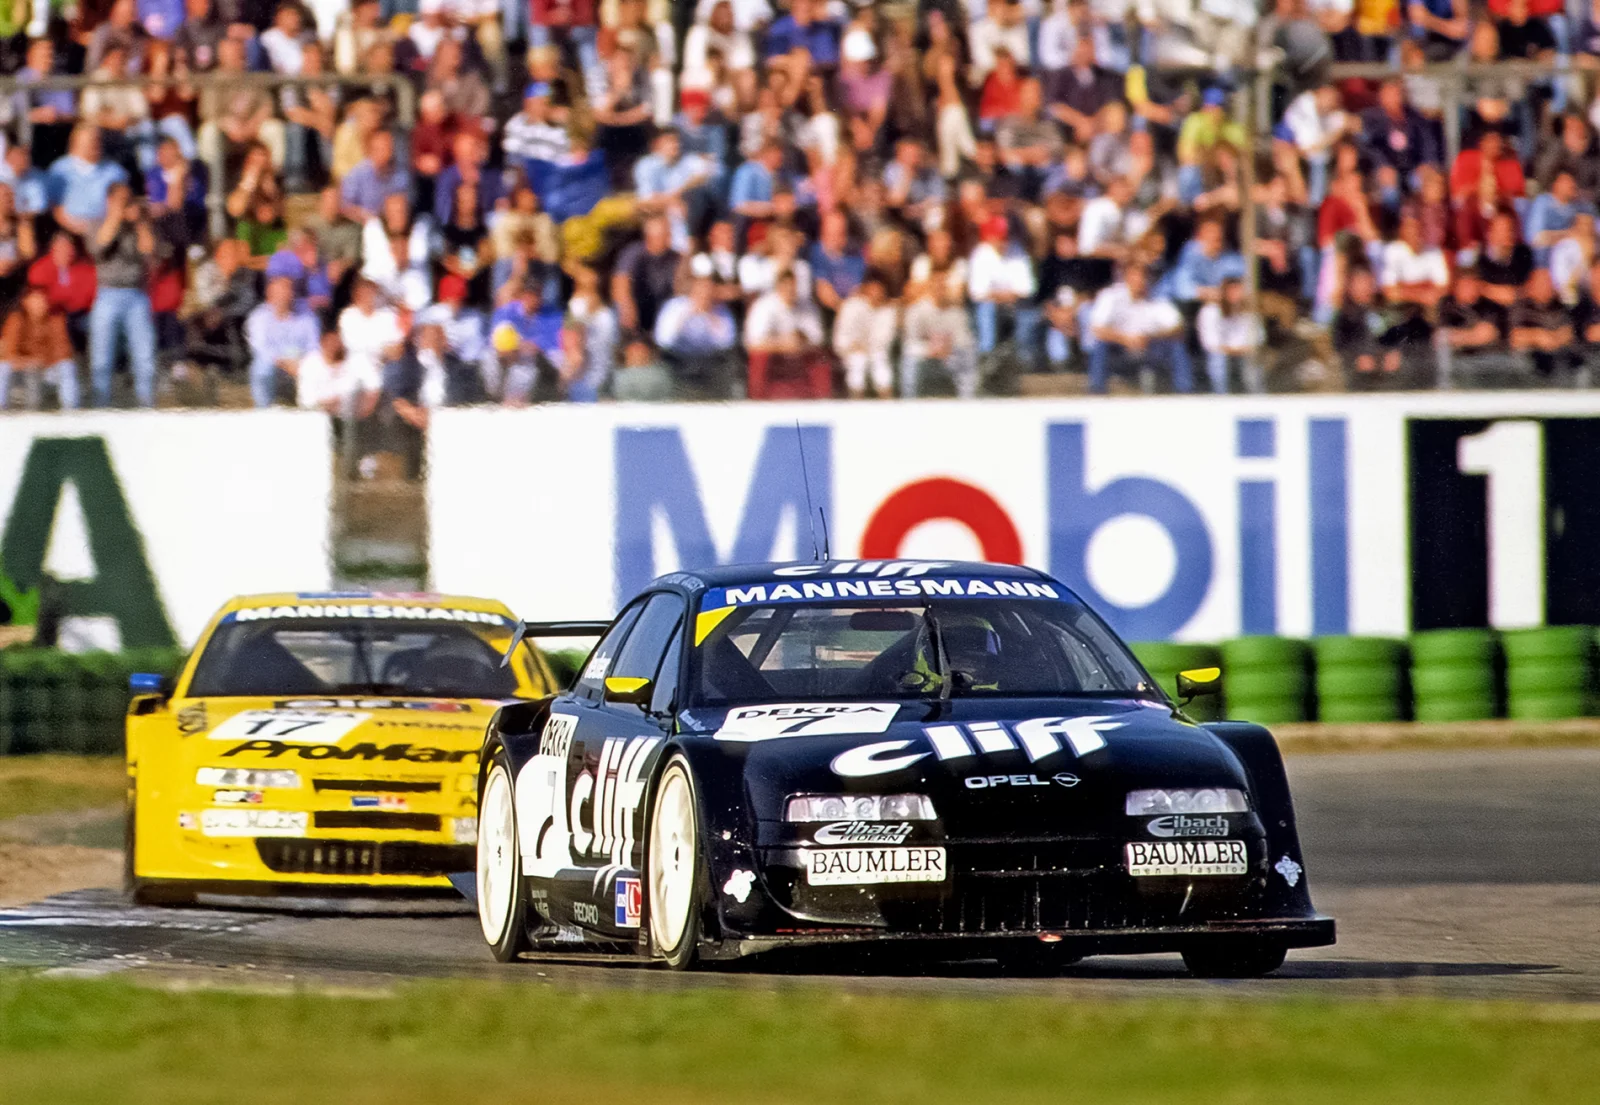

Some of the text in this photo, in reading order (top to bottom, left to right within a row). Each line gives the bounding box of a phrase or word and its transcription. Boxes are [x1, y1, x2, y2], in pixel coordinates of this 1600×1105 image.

[611, 416, 1544, 637] Mobil 1
[773, 561, 954, 577] cliff
[725, 580, 1059, 604] MANNESMANN
[236, 605, 504, 625] MANNESMANN
[736, 706, 886, 719] DEKRA
[246, 719, 325, 735] 17
[776, 715, 836, 734] 7
[829, 716, 1129, 777] cliff
[965, 775, 1050, 789] OPEL
[571, 736, 663, 898] cliff
[1147, 815, 1229, 837] Eibach
[814, 821, 913, 844] Eibach
[812, 849, 942, 874] BÄUMLER
